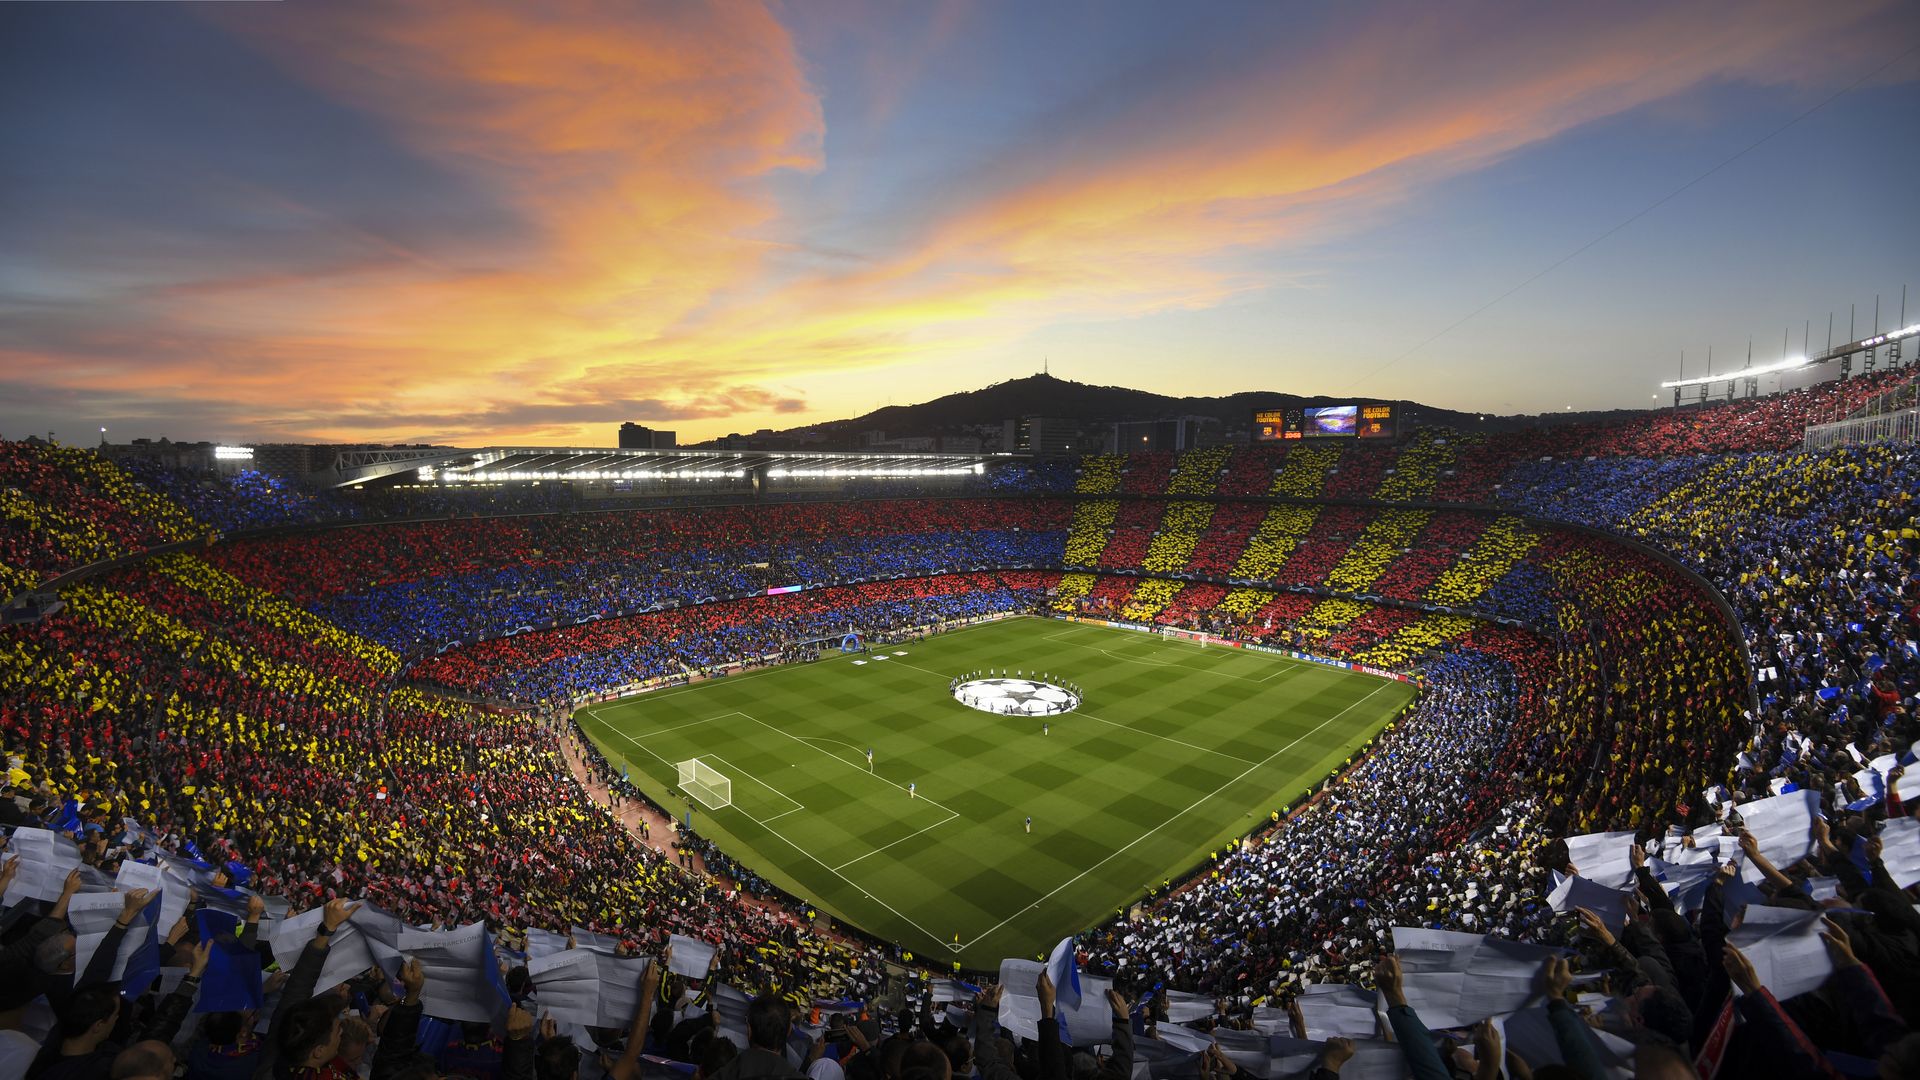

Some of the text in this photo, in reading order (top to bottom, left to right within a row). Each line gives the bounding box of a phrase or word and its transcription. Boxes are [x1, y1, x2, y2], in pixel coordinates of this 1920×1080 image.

[1205, 635, 1234, 647] Santander
[1245, 643, 1282, 655] Heineken
[1362, 666, 1399, 681] NISSAN
